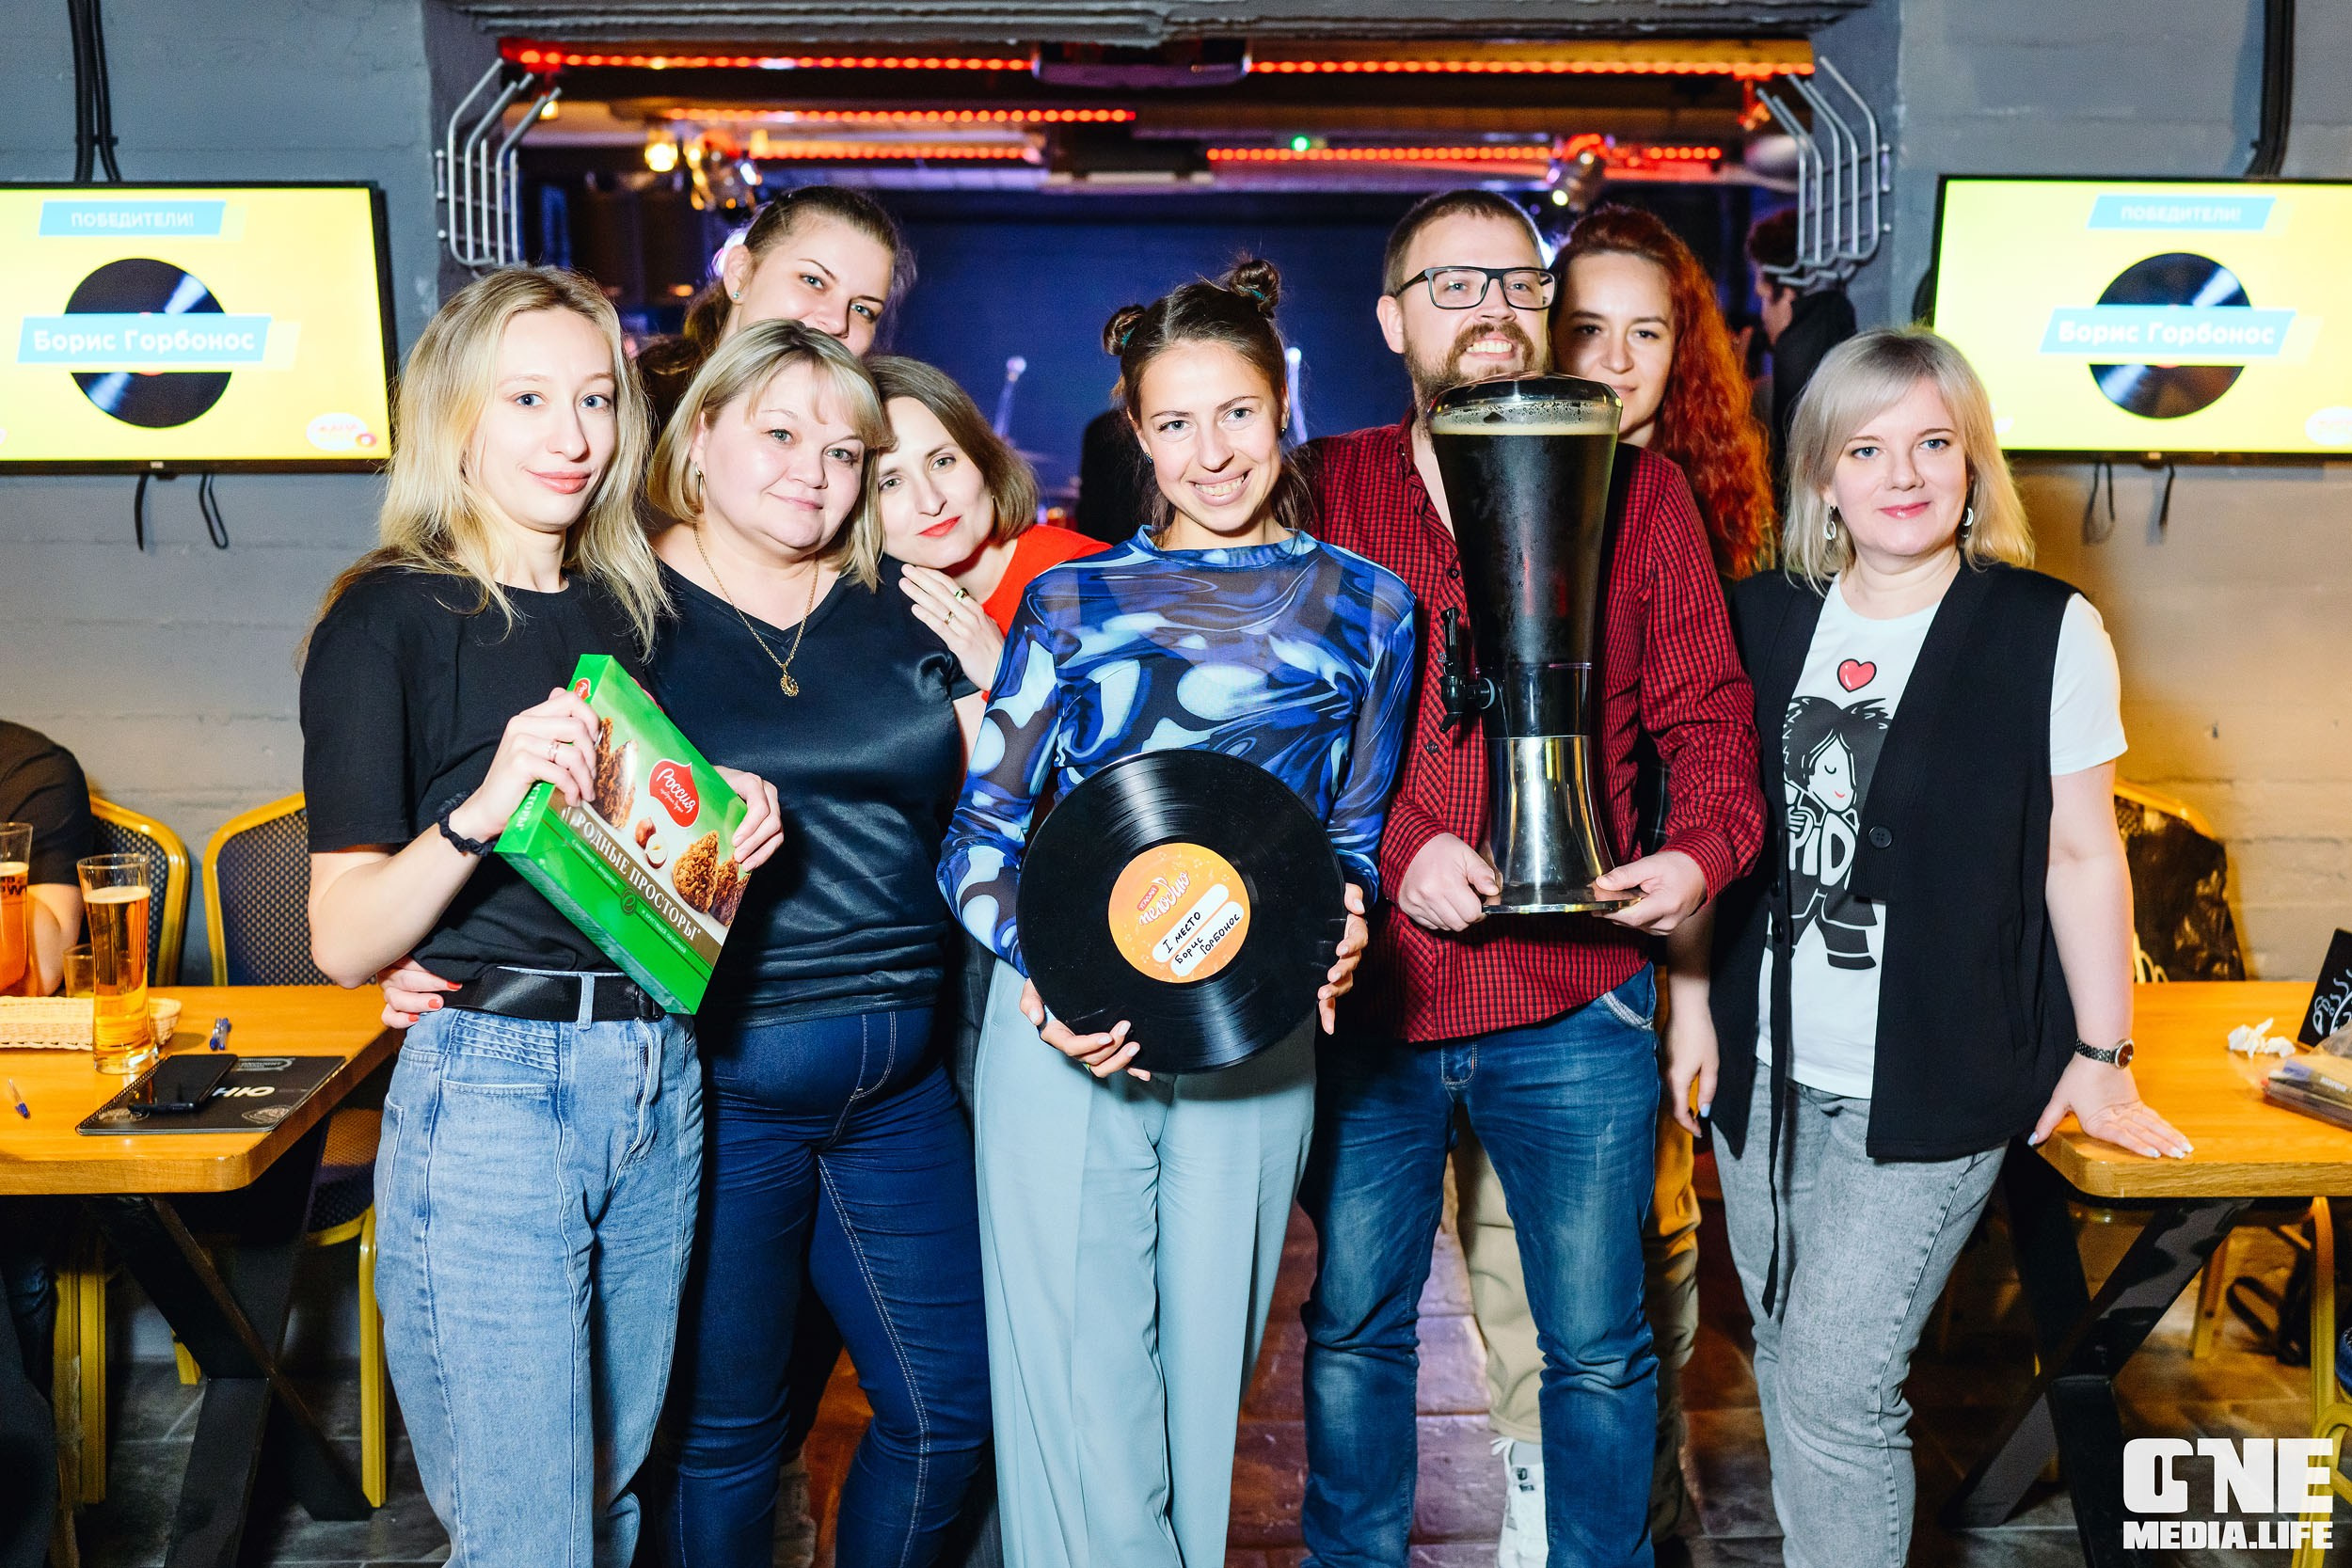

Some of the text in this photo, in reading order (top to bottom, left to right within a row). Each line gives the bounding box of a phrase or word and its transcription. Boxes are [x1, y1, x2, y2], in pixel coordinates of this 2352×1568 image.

[71, 212, 195, 229] ПОБЕДИТЕЛИ!
[2121, 205, 2241, 224] ПОБЕДИТЕЛИ!
[33, 328, 256, 355] Борис Горбонос
[2058, 321, 2276, 347] Борис Горбонос
[655, 768, 696, 814] Россия
